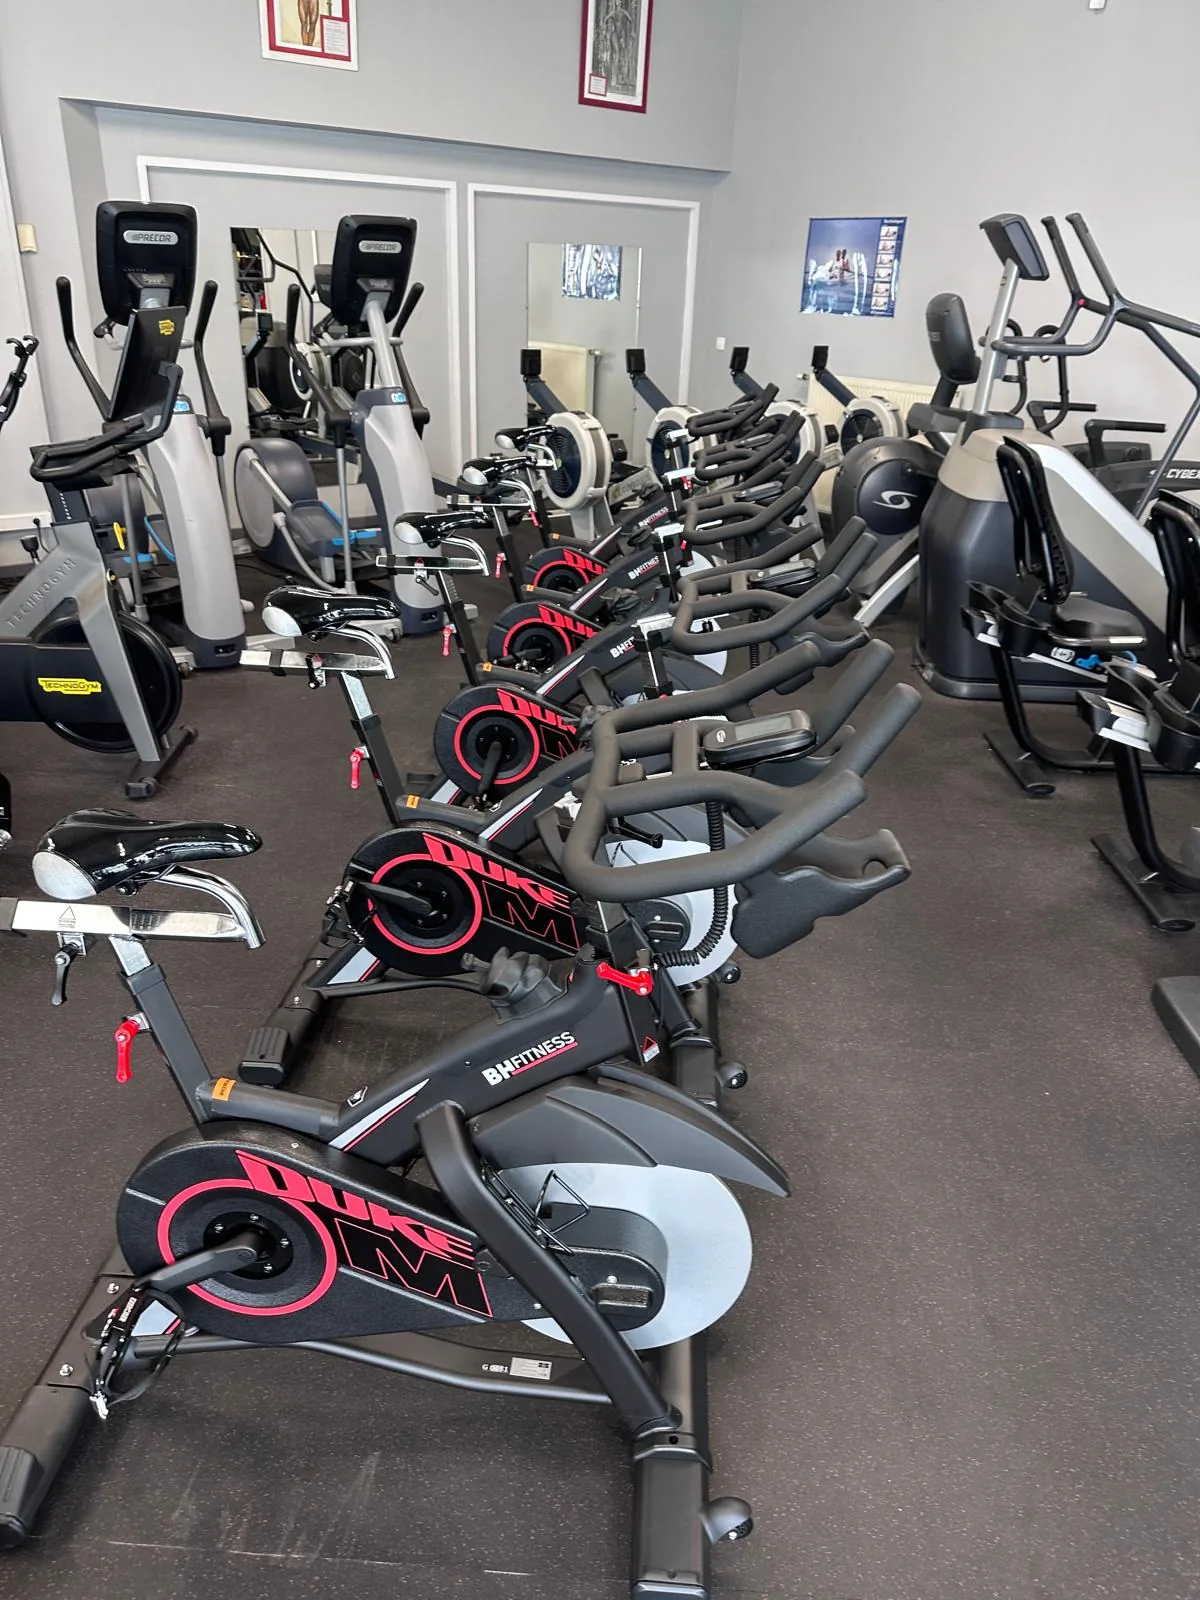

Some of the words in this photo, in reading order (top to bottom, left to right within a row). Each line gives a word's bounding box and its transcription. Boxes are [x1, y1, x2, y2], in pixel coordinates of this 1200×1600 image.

[136, 233, 172, 243] PRECOR
[7, 558, 76, 629] TECHNOGYM
[628, 555, 660, 580] BHFITNES
[422, 832, 571, 909] DUKE
[481, 880, 581, 951] M
[235, 1150, 475, 1261] DUKE
[334, 1217, 493, 1318] M
